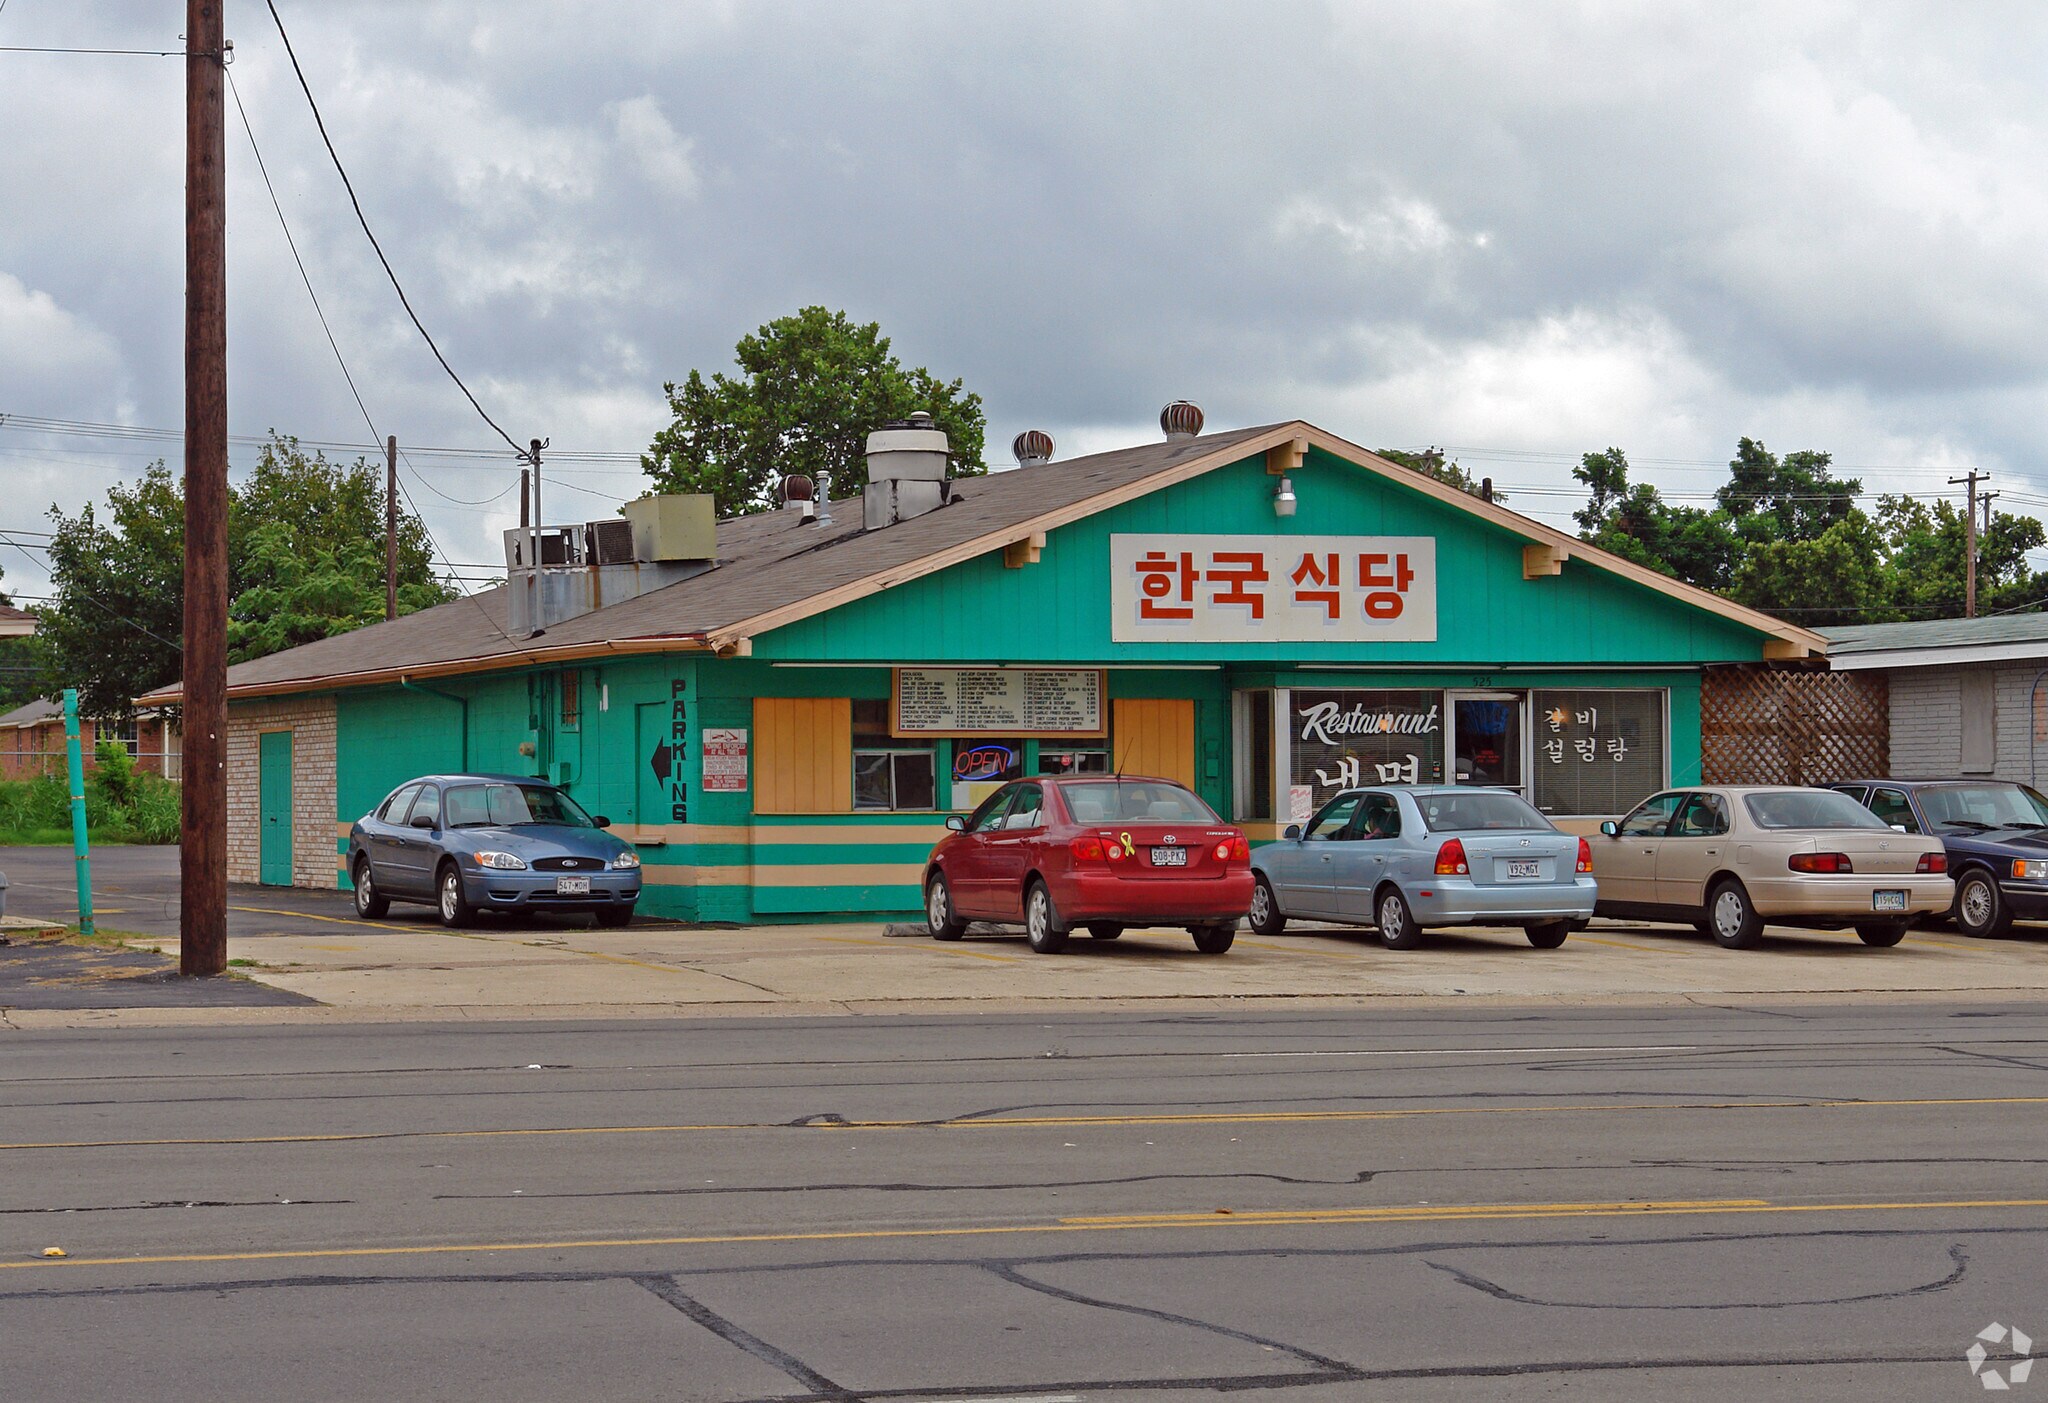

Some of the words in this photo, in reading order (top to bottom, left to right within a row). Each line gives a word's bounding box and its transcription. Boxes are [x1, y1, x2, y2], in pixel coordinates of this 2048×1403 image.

[1132, 551, 1415, 621] 한국식당
[1473, 677, 1492, 687] 525
[1299, 701, 1438, 745] Restaurant
[671, 679, 687, 824] PARKING
[956, 752, 1008, 774] OPEN
